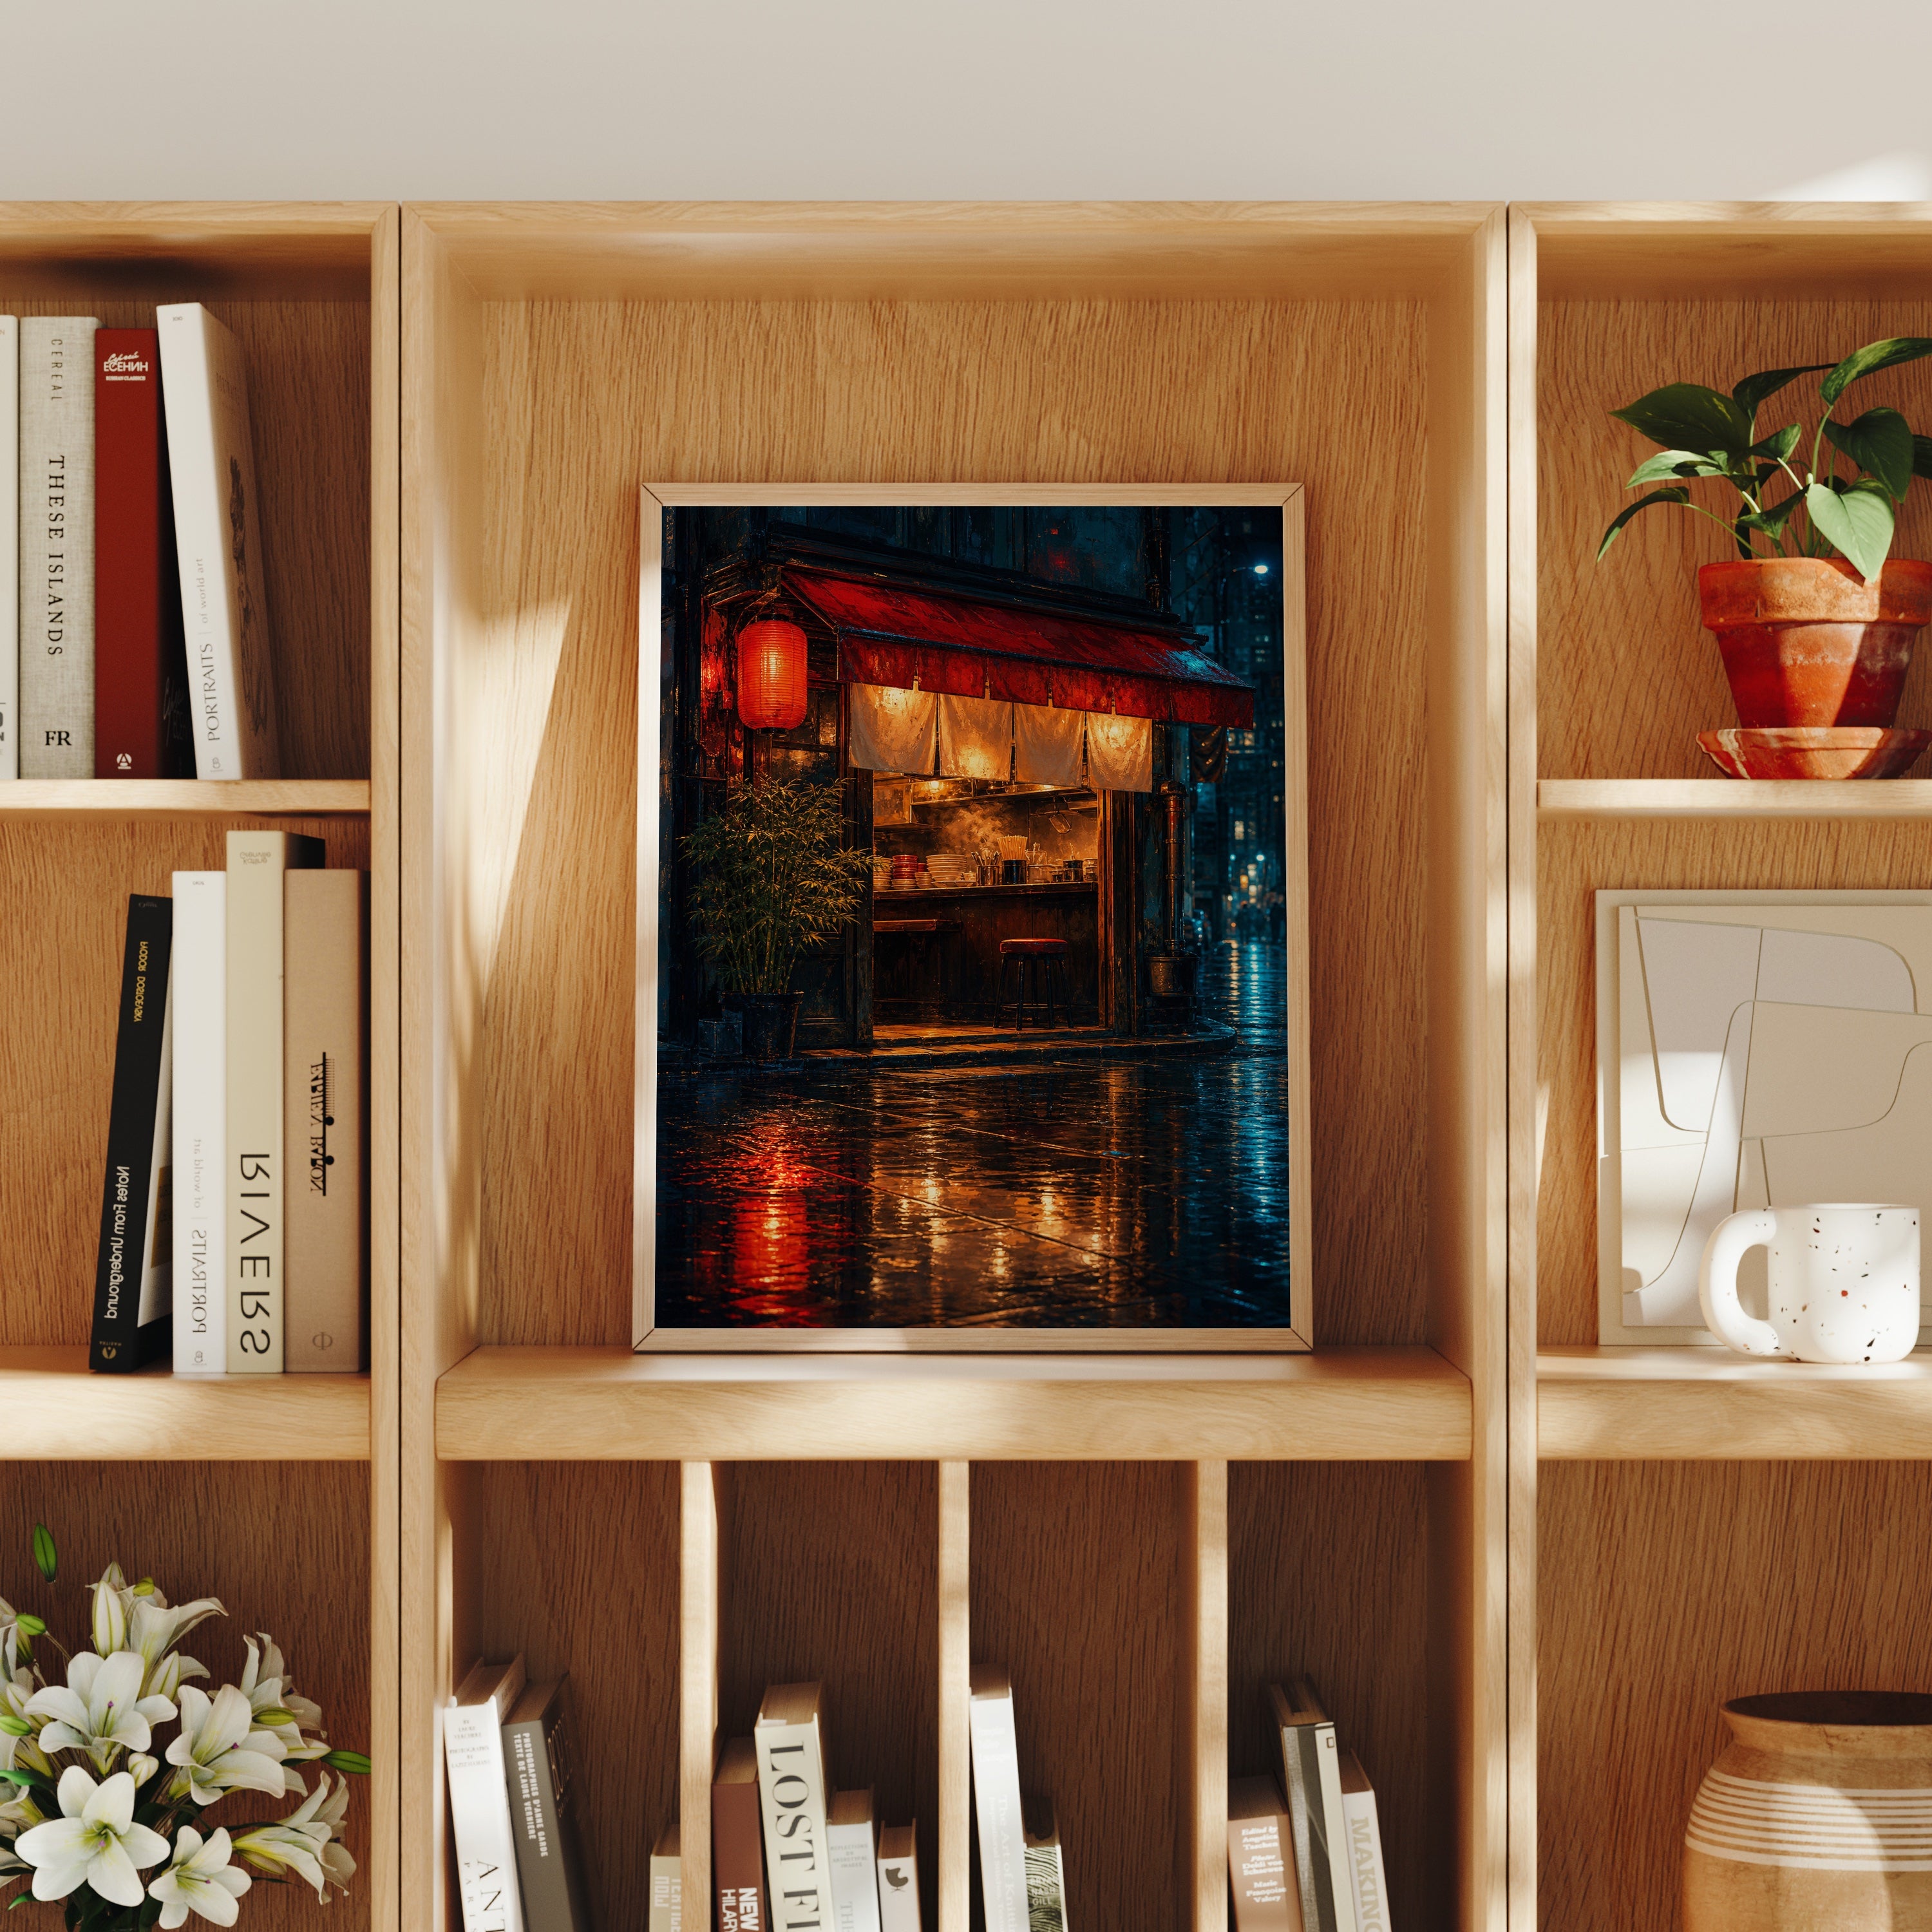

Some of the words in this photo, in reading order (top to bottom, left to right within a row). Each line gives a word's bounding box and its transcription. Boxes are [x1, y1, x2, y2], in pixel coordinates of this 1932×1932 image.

[51, 339, 62, 401] CEREAL
[103, 361, 148, 372] ЕСЕНИН
[48, 455, 65, 540] THESE
[195, 558, 204, 574] art
[48, 553, 65, 656] ISLANDS
[196, 577, 207, 609] world
[202, 612, 209, 623] of
[200, 644, 220, 741] PORTRAITS
[45, 730, 72, 746] FR
[513, 1734, 524, 1759] TEXTE
[517, 1760, 526, 1771] DE
[519, 1774, 531, 1799] LAURE
[522, 1732, 539, 1797] PHOTOGRAPHIES
[538, 1830, 549, 1857] GARDE
[769, 1741, 815, 1871] LOST
[1031, 1887, 1056, 1896] NASH
[1032, 1897, 1052, 1906] GILL
[739, 1887, 759, 1931] NEW
